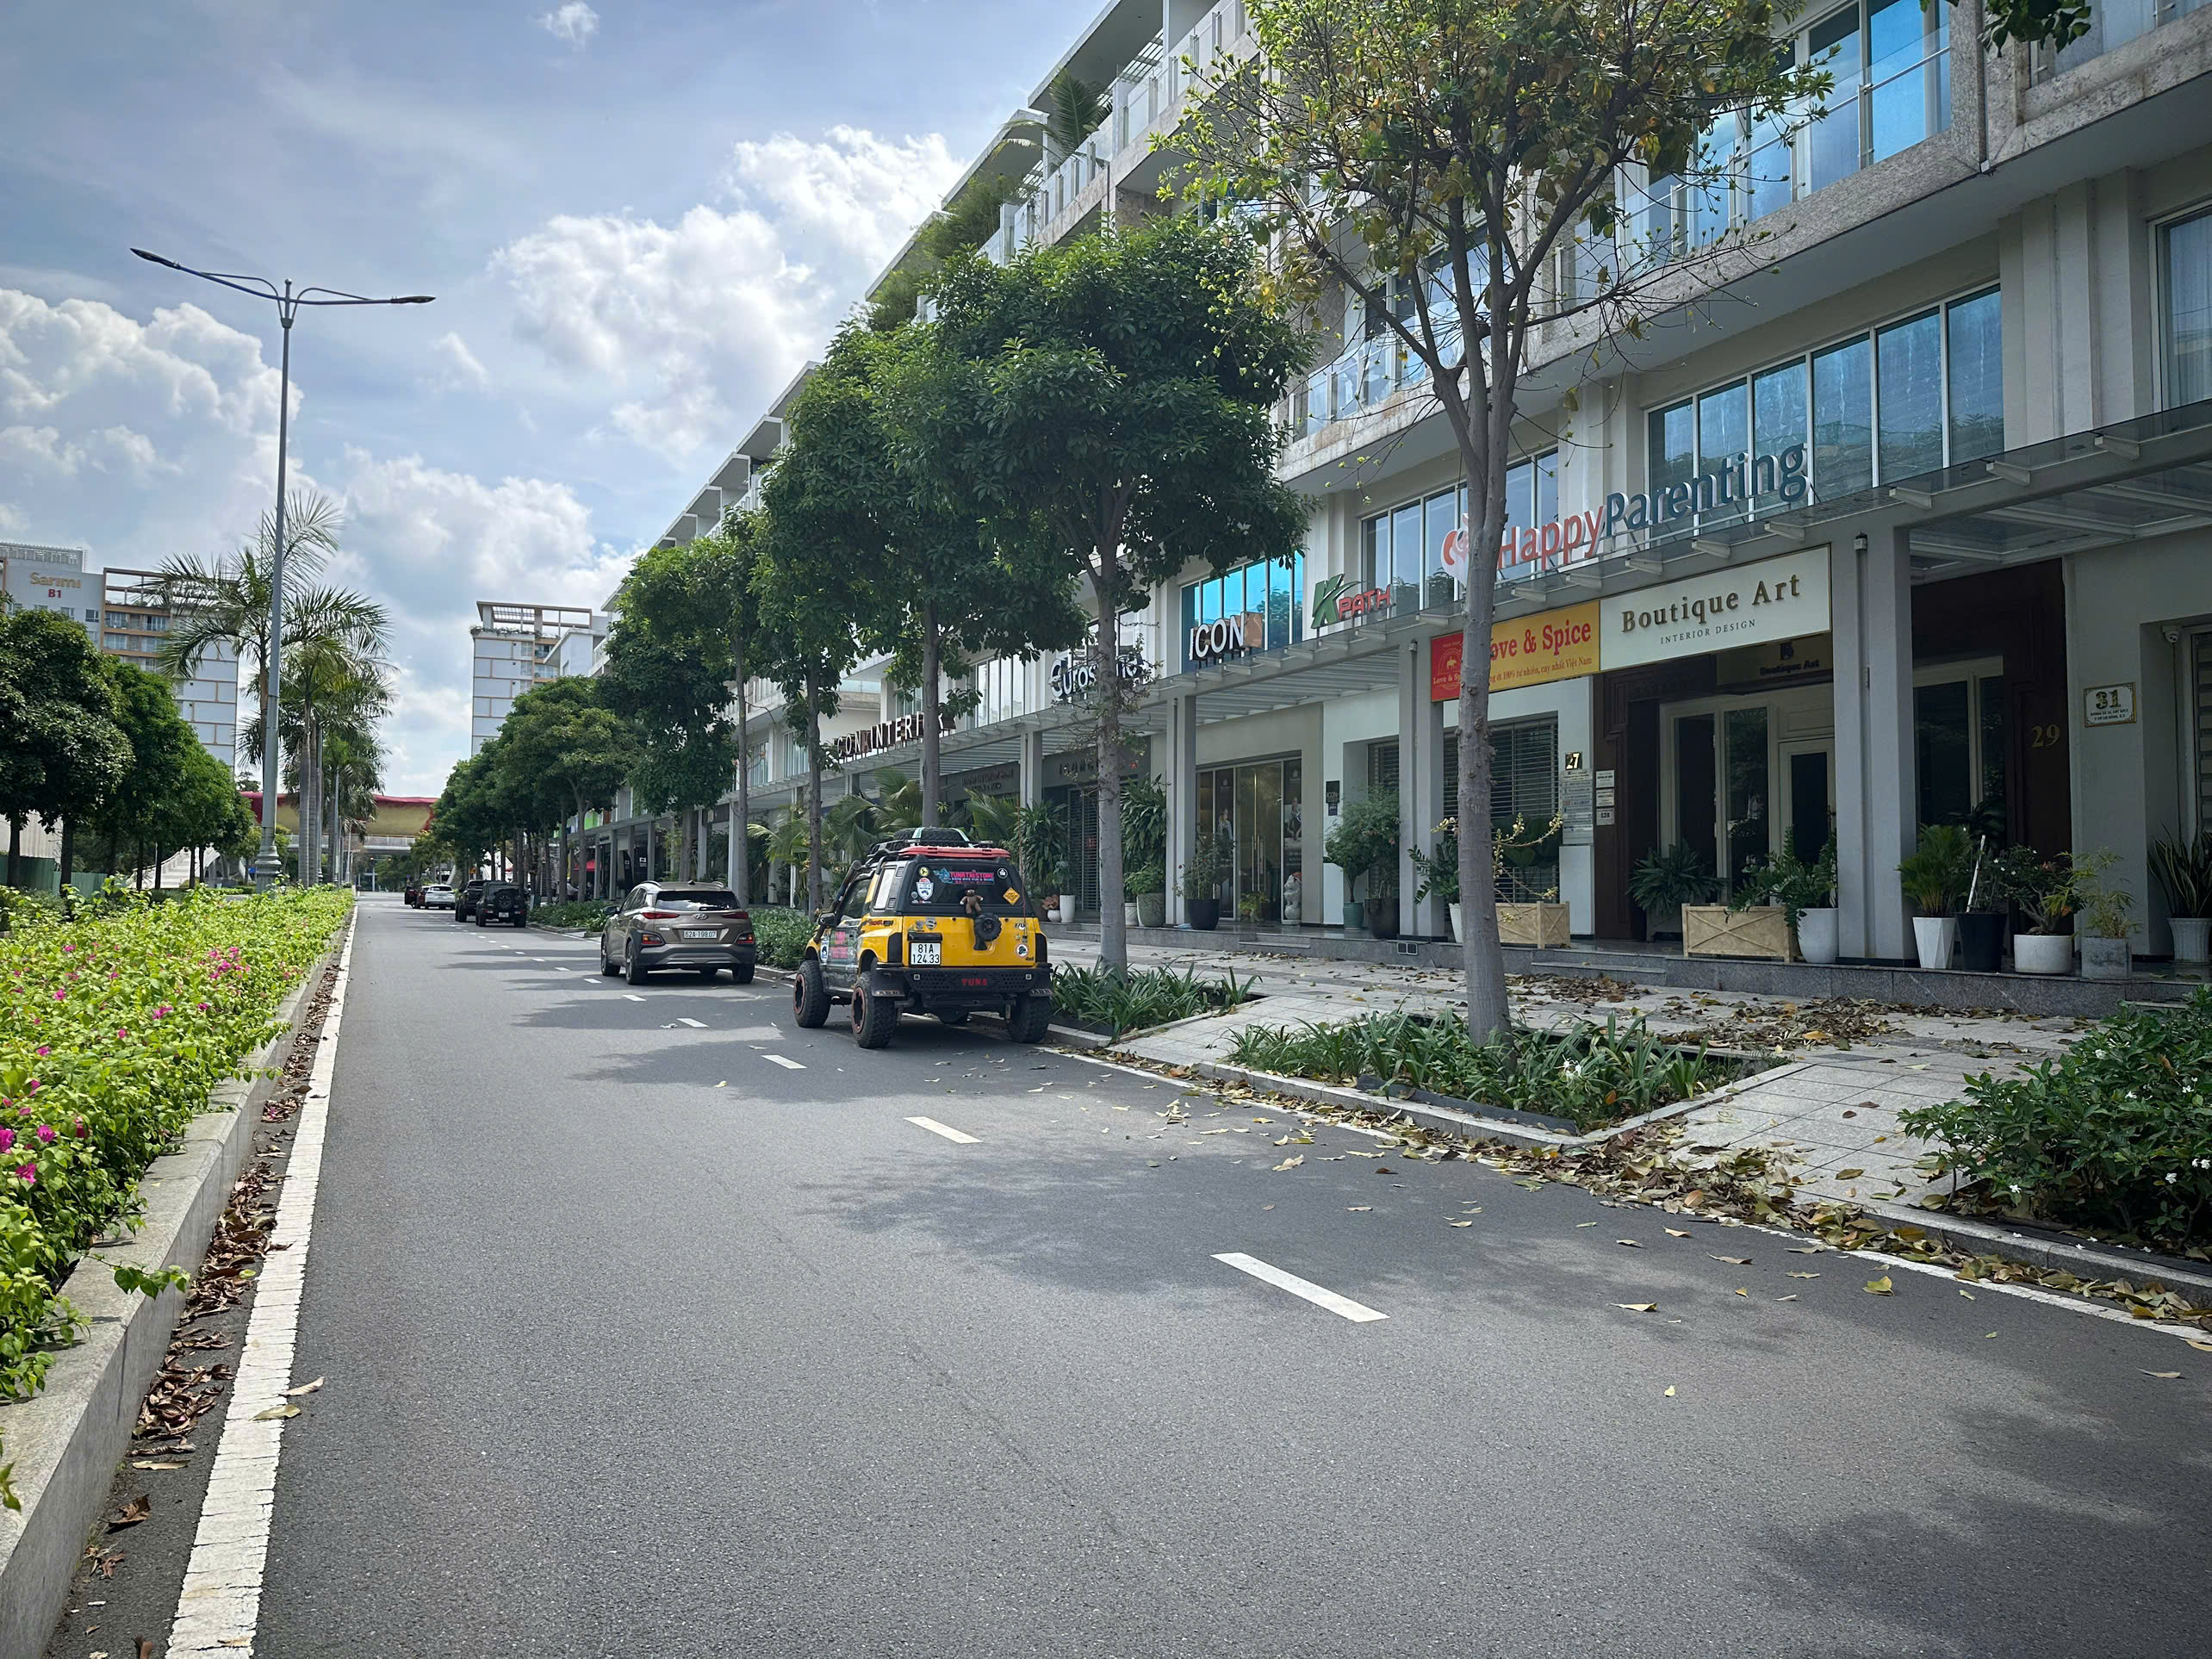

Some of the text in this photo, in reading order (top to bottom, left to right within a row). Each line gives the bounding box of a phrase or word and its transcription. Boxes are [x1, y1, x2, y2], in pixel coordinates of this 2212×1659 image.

[48, 588, 62, 598] B1
[1621, 575, 1799, 633] Boutique Art
[1189, 612, 1246, 661] ICON
[1490, 618, 1592, 661] ove & Spice
[1660, 619, 1756, 644] INTERIOR DESIGN
[2095, 689, 2122, 709] 31
[2032, 724, 2060, 748] 29
[1566, 752, 1581, 769] 27
[913, 954, 940, 964] 124.33
[917, 944, 934, 954] 81A
